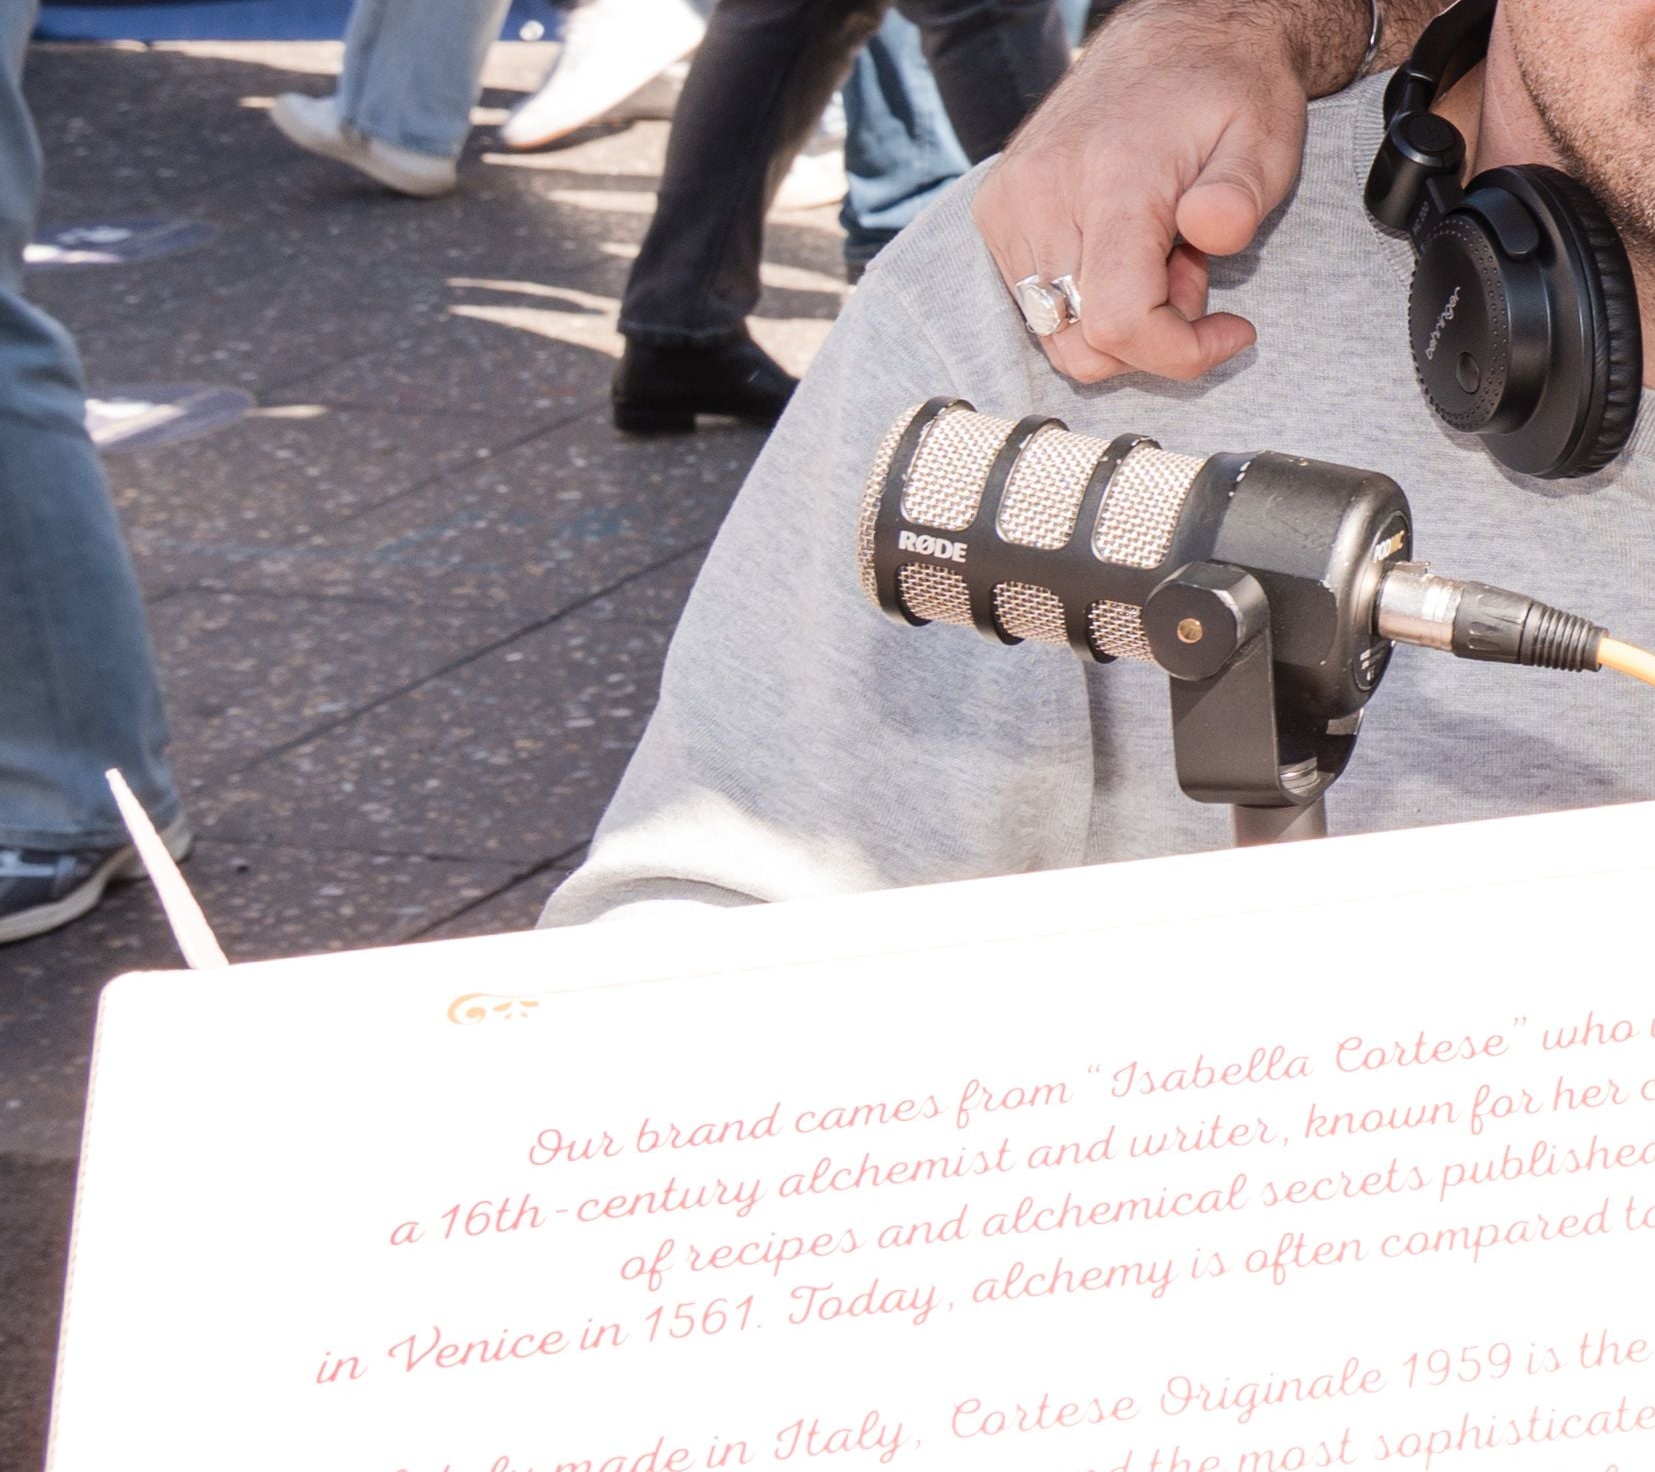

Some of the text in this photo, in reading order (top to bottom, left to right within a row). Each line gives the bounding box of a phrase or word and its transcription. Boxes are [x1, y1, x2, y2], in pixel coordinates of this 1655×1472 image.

[1424, 286, 1461, 361] behringer
[899, 530, 968, 563] RØDE
[527, 1127, 625, 1167] Our
[634, 1100, 783, 1154] brand
[792, 1093, 947, 1136] cames
[954, 1076, 1075, 1130] from
[1541, 1008, 1641, 1052] who
[388, 1219, 427, 1247] a
[777, 1136, 1017, 1199] alchemist
[1026, 1123, 1117, 1170] and
[1303, 1099, 1461, 1139] known
[1469, 1082, 1544, 1137] for
[1551, 1073, 1630, 1113] her
[618, 1236, 677, 1294] of
[685, 1226, 867, 1278] recipes
[876, 1201, 970, 1250] and
[980, 1171, 1249, 1238] alchemical
[1260, 1156, 1431, 1208] secrets
[314, 1349, 369, 1386] in
[385, 1323, 571, 1374] Venice
[578, 1317, 630, 1352] in
[971, 1255, 1180, 1304] alchemy
[1189, 1246, 1232, 1281] is
[1243, 1230, 1369, 1287] often
[1379, 1196, 1612, 1264] compared
[705, 1433, 754, 1470] in
[949, 1391, 1139, 1440] Cortese
[1159, 1355, 1387, 1425] Originale
[1401, 1340, 1512, 1389] 1959
[1525, 1341, 1568, 1376] is
[1578, 1327, 1651, 1370] the
